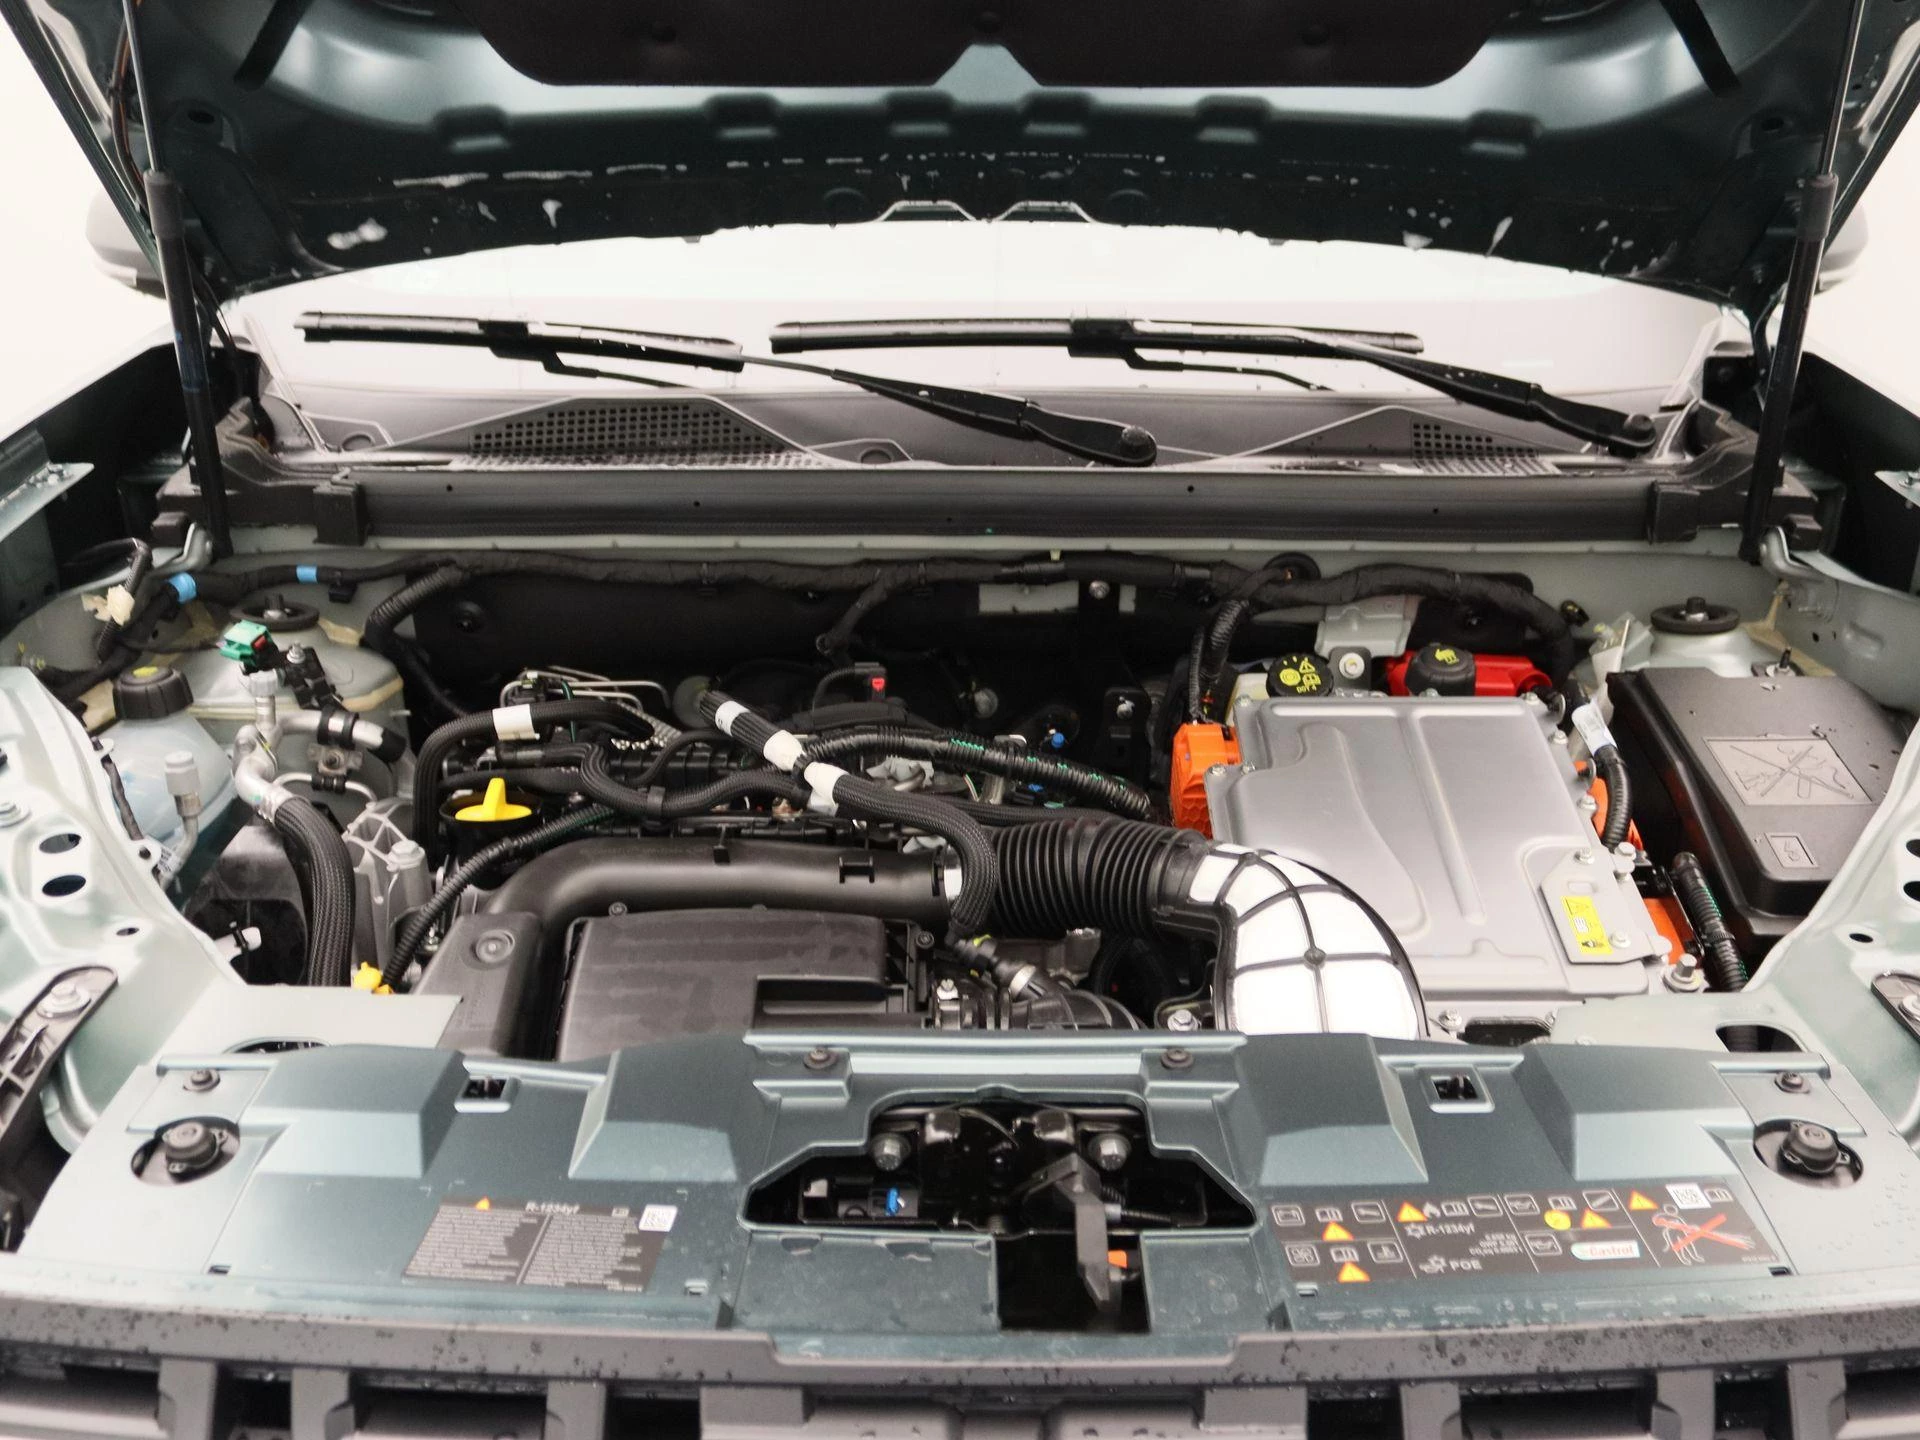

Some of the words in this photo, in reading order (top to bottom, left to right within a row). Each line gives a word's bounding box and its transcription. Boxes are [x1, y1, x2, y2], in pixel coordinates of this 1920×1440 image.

[1425, 1222, 1475, 1235] R-1234yf
[1589, 1244, 1633, 1256] Castrol
[1449, 1259, 1482, 1271] POE
